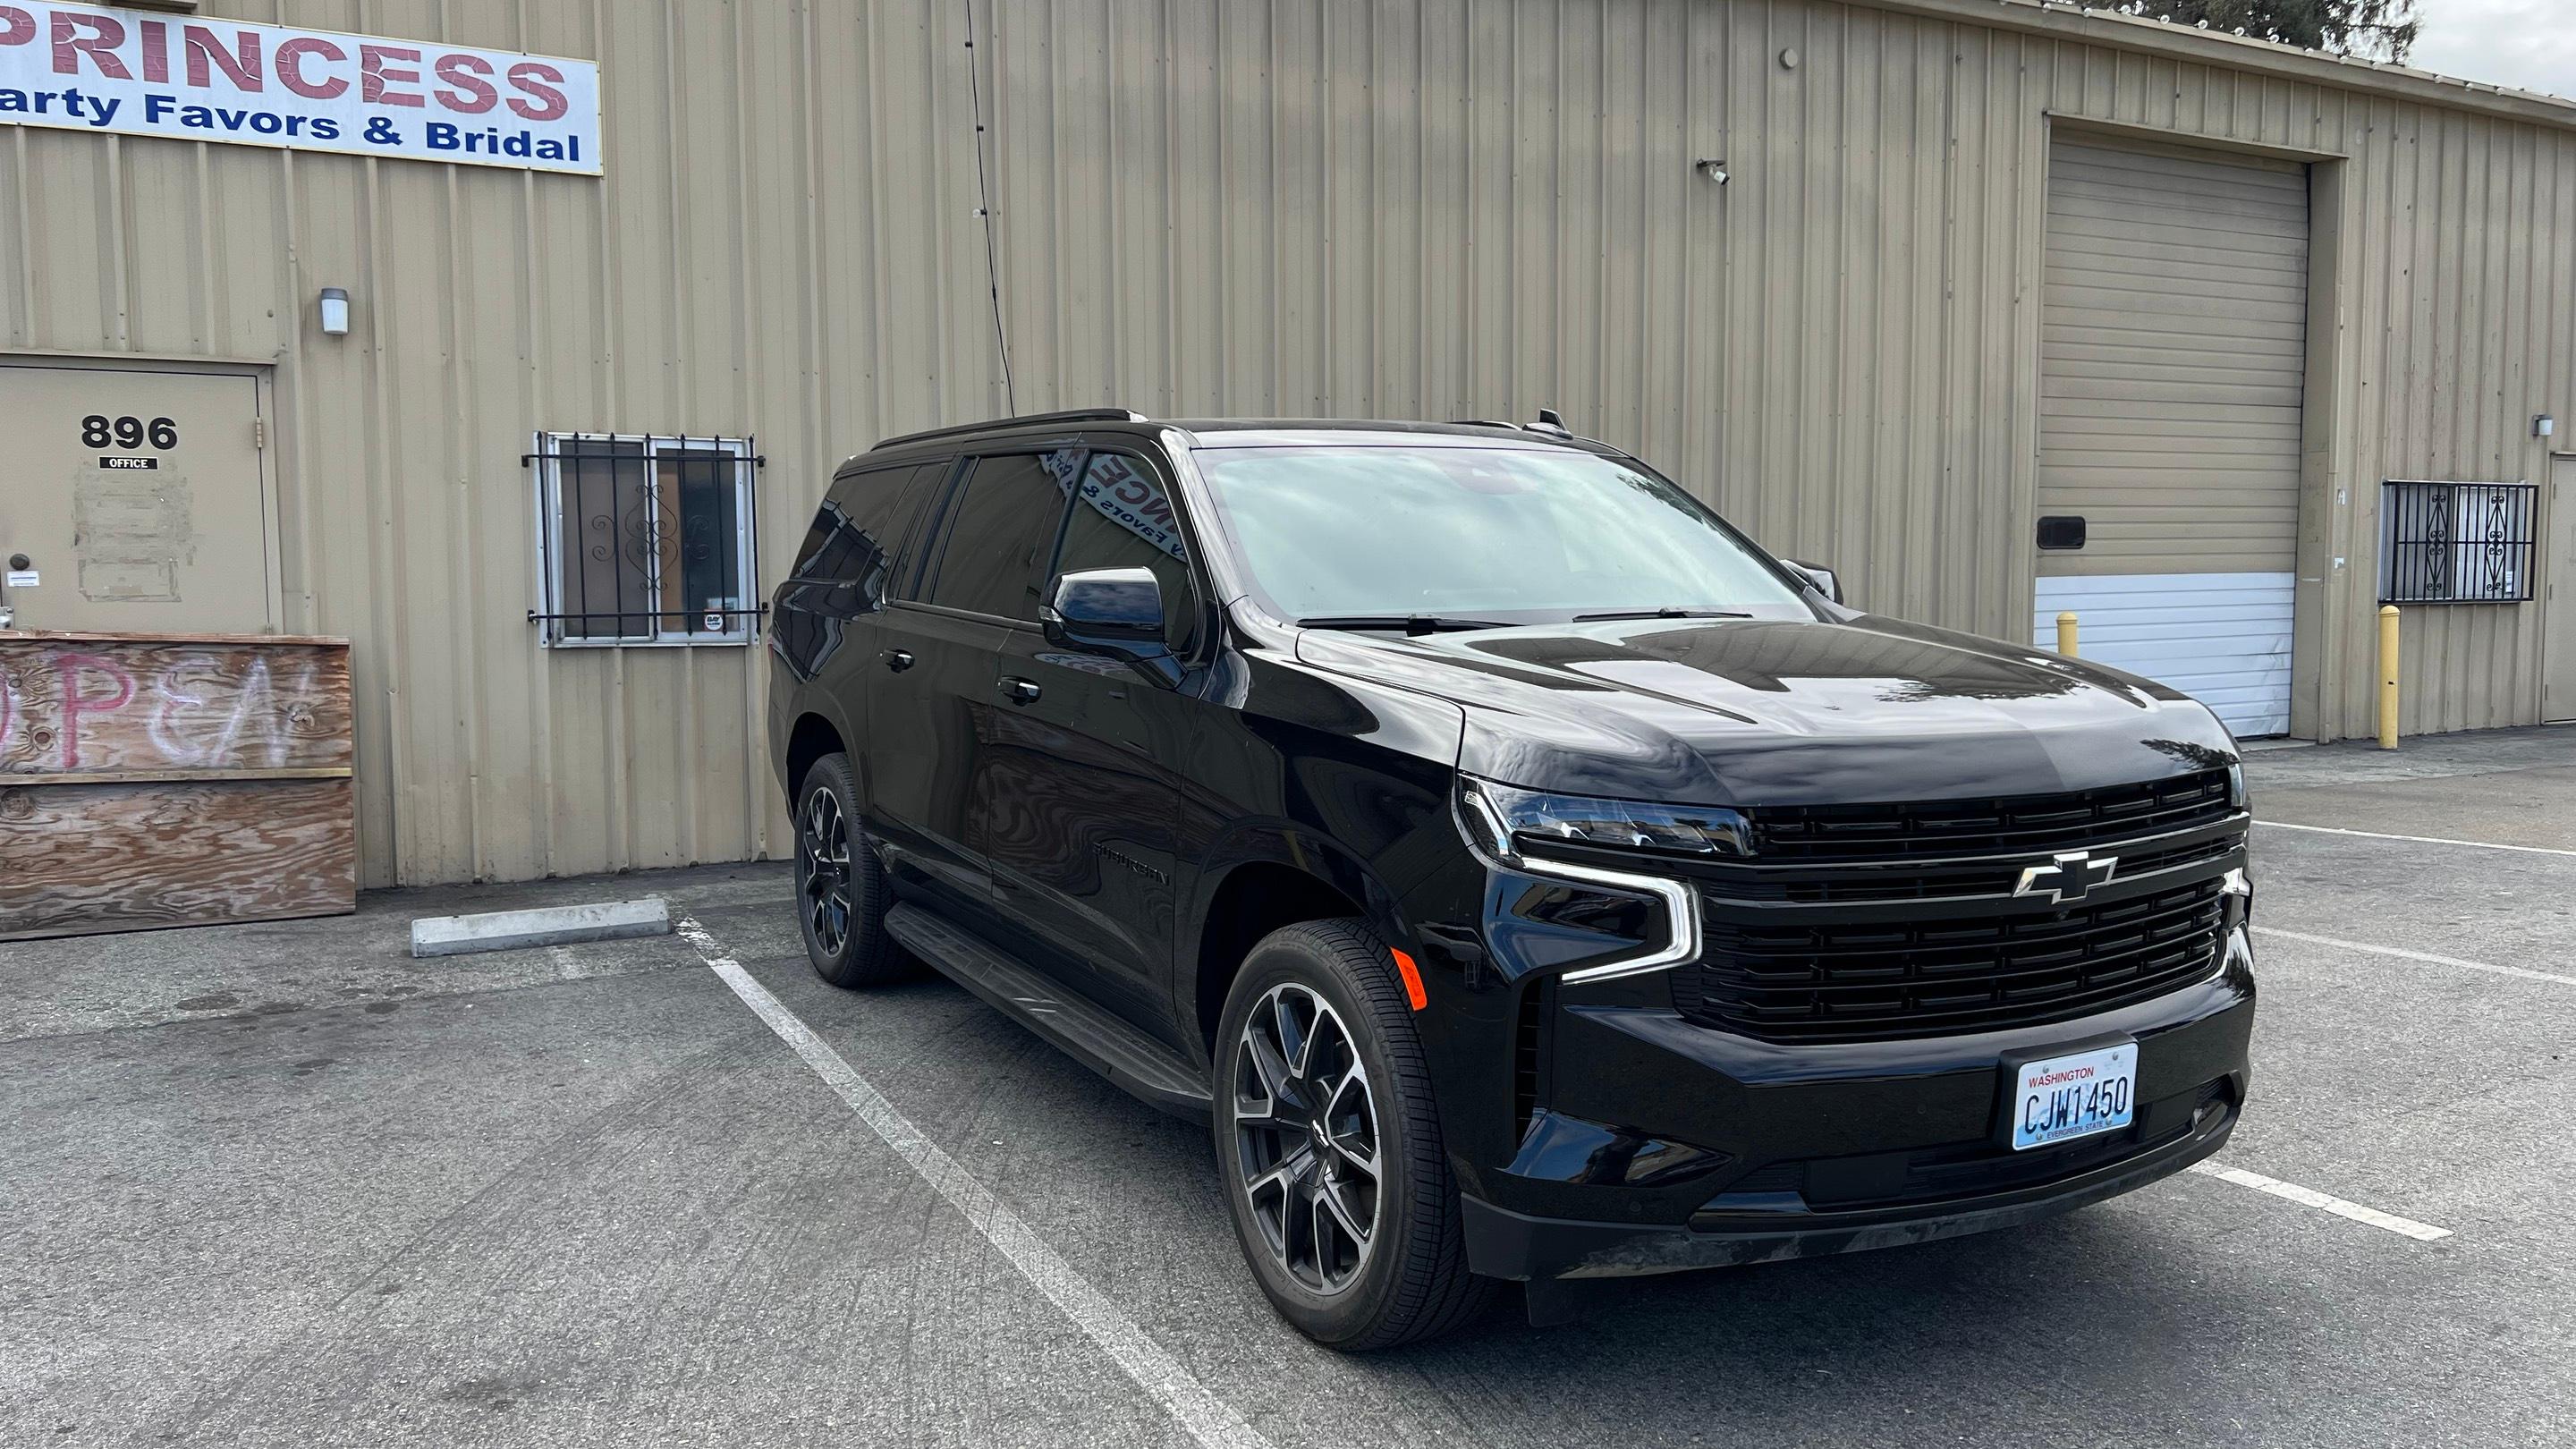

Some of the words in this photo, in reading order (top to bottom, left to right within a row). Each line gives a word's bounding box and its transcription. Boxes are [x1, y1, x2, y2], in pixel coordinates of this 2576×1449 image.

[144, 94, 342, 140] Favors
[362, 116, 404, 147] &
[426, 122, 580, 162] Bridal
[81, 415, 178, 450] 896
[109, 459, 148, 469] OFFICE
[0, 653, 320, 769] PEN
[2029, 1066, 2095, 1089] WASHINGTON
[2024, 1076, 2129, 1134] CJW1450
[2046, 1124, 2083, 1140] EVERGREEN
[2085, 1120, 2104, 1131] STATE
